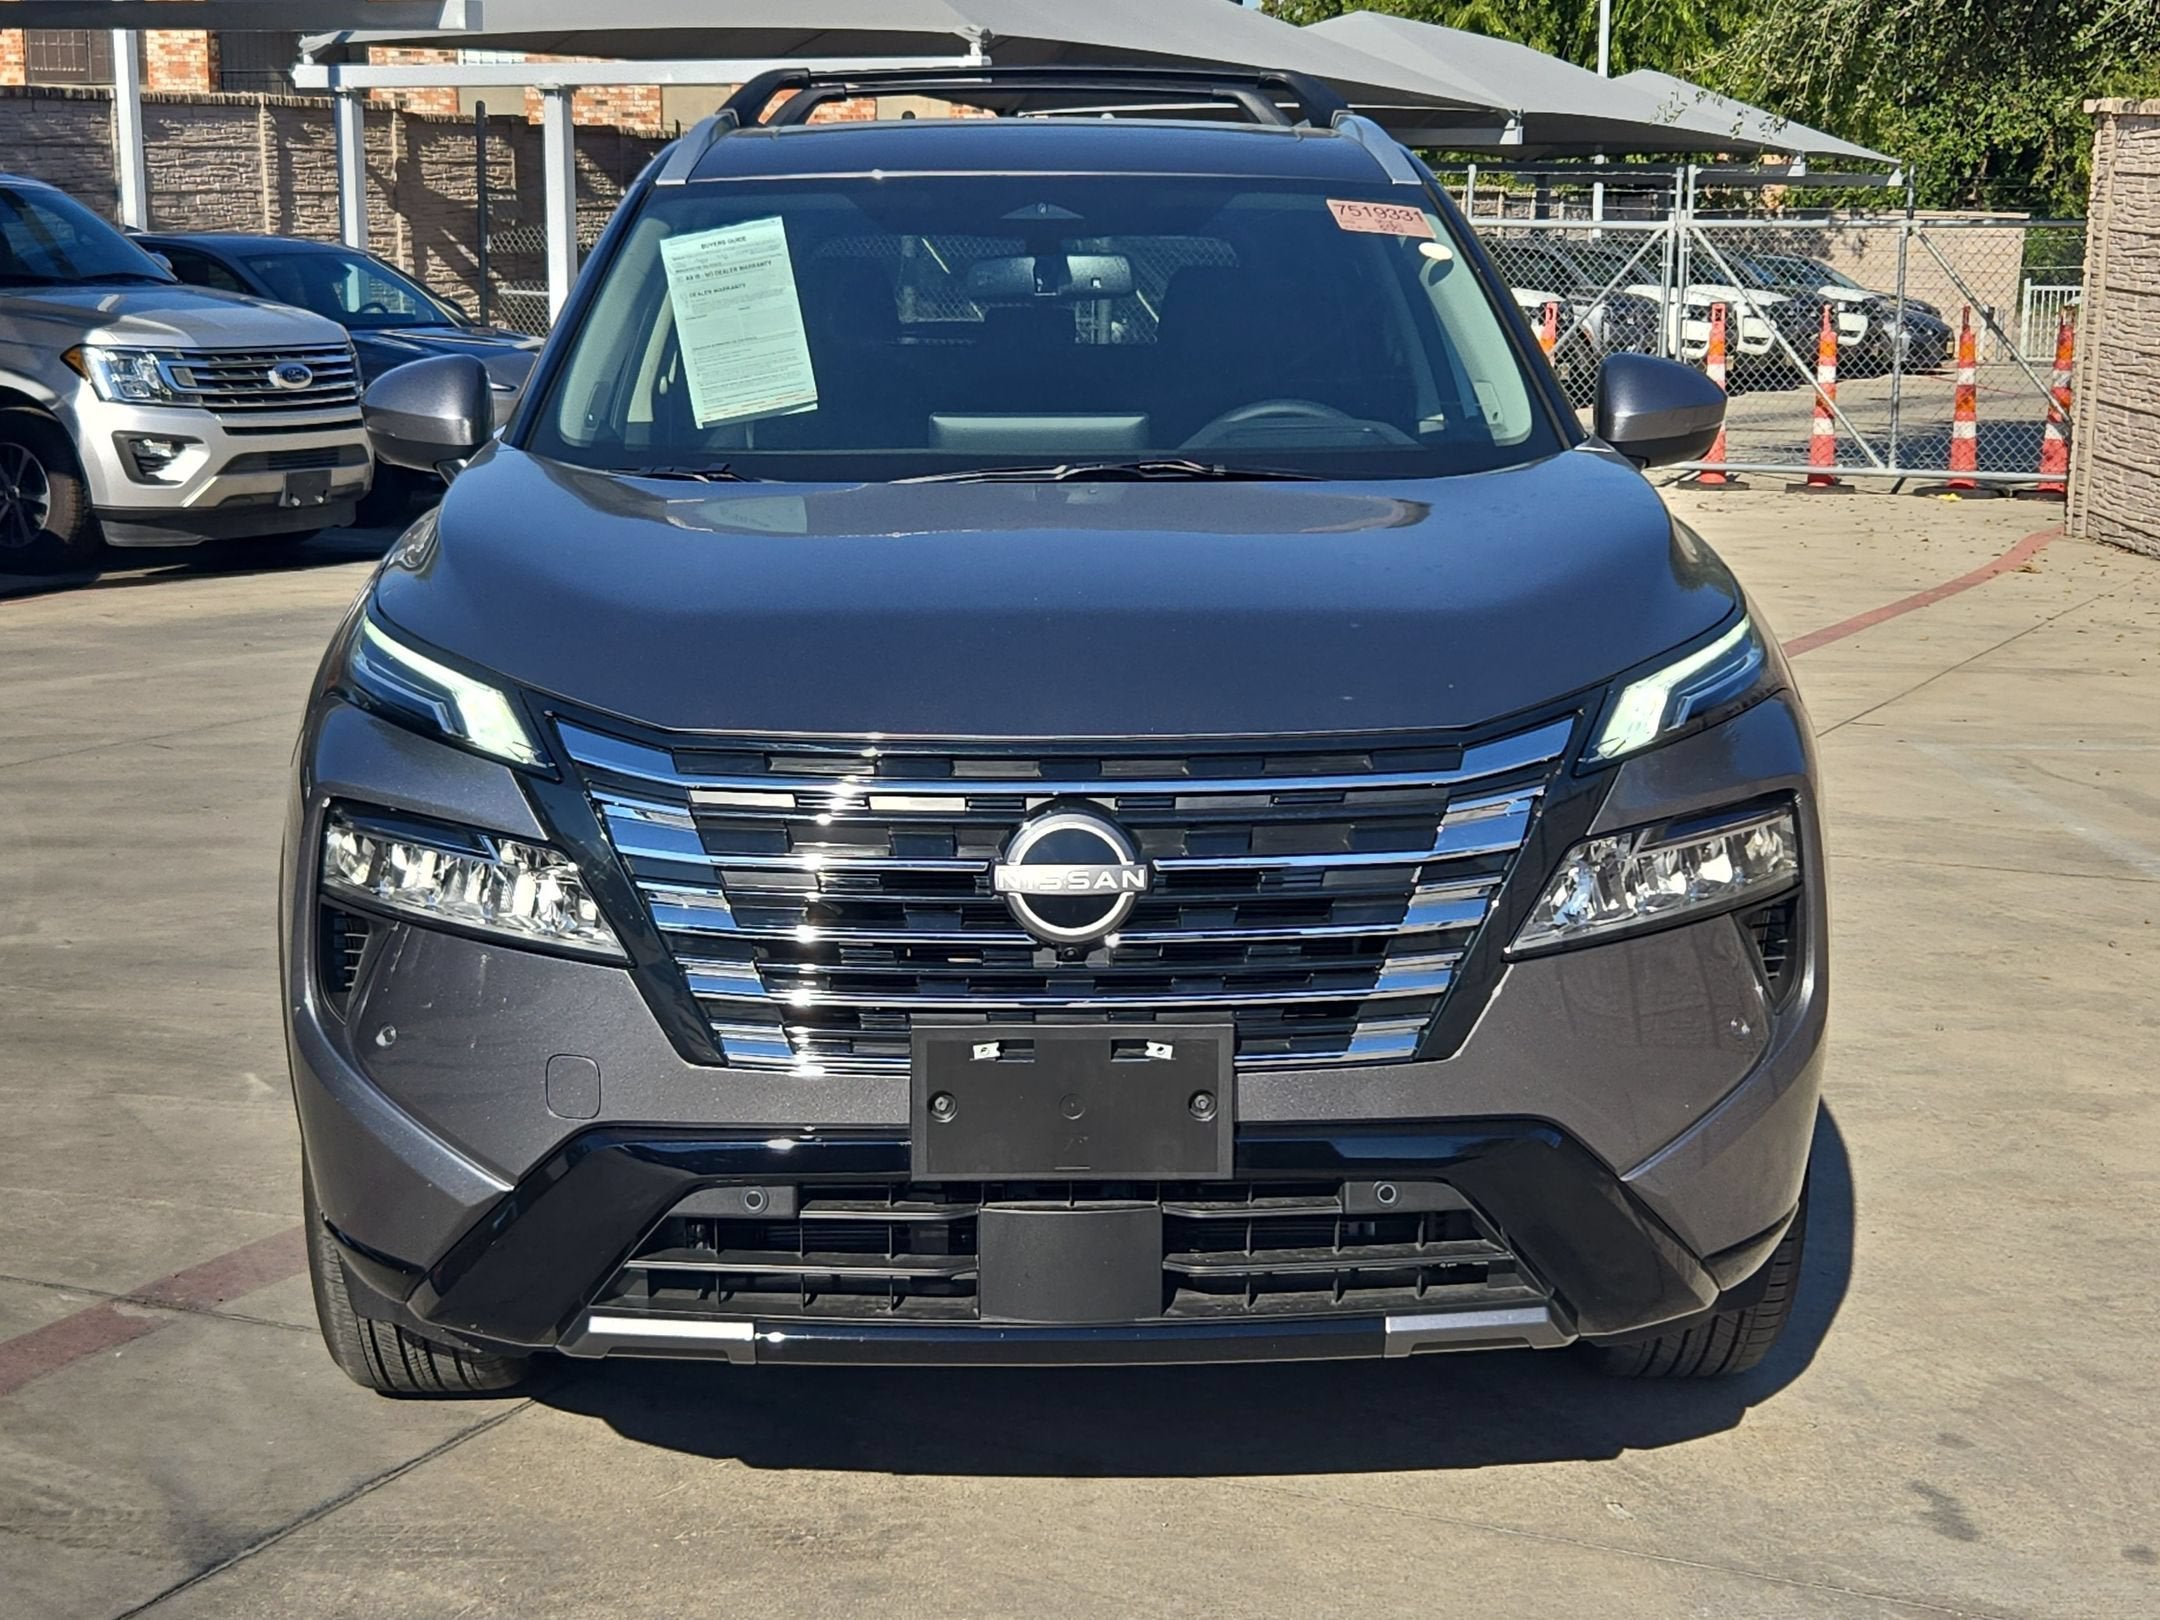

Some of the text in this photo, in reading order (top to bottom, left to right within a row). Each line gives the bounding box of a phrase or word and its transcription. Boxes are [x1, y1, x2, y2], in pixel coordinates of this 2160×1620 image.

[1333, 204, 1424, 223] 7519331
[701, 236, 746, 249] BUYERS GUIDE
[715, 267, 738, 276] DEALER
[739, 260, 772, 270] WARRANTY
[689, 283, 746, 297] DEALER WARRANTY
[998, 868, 1145, 890] NISSAN
